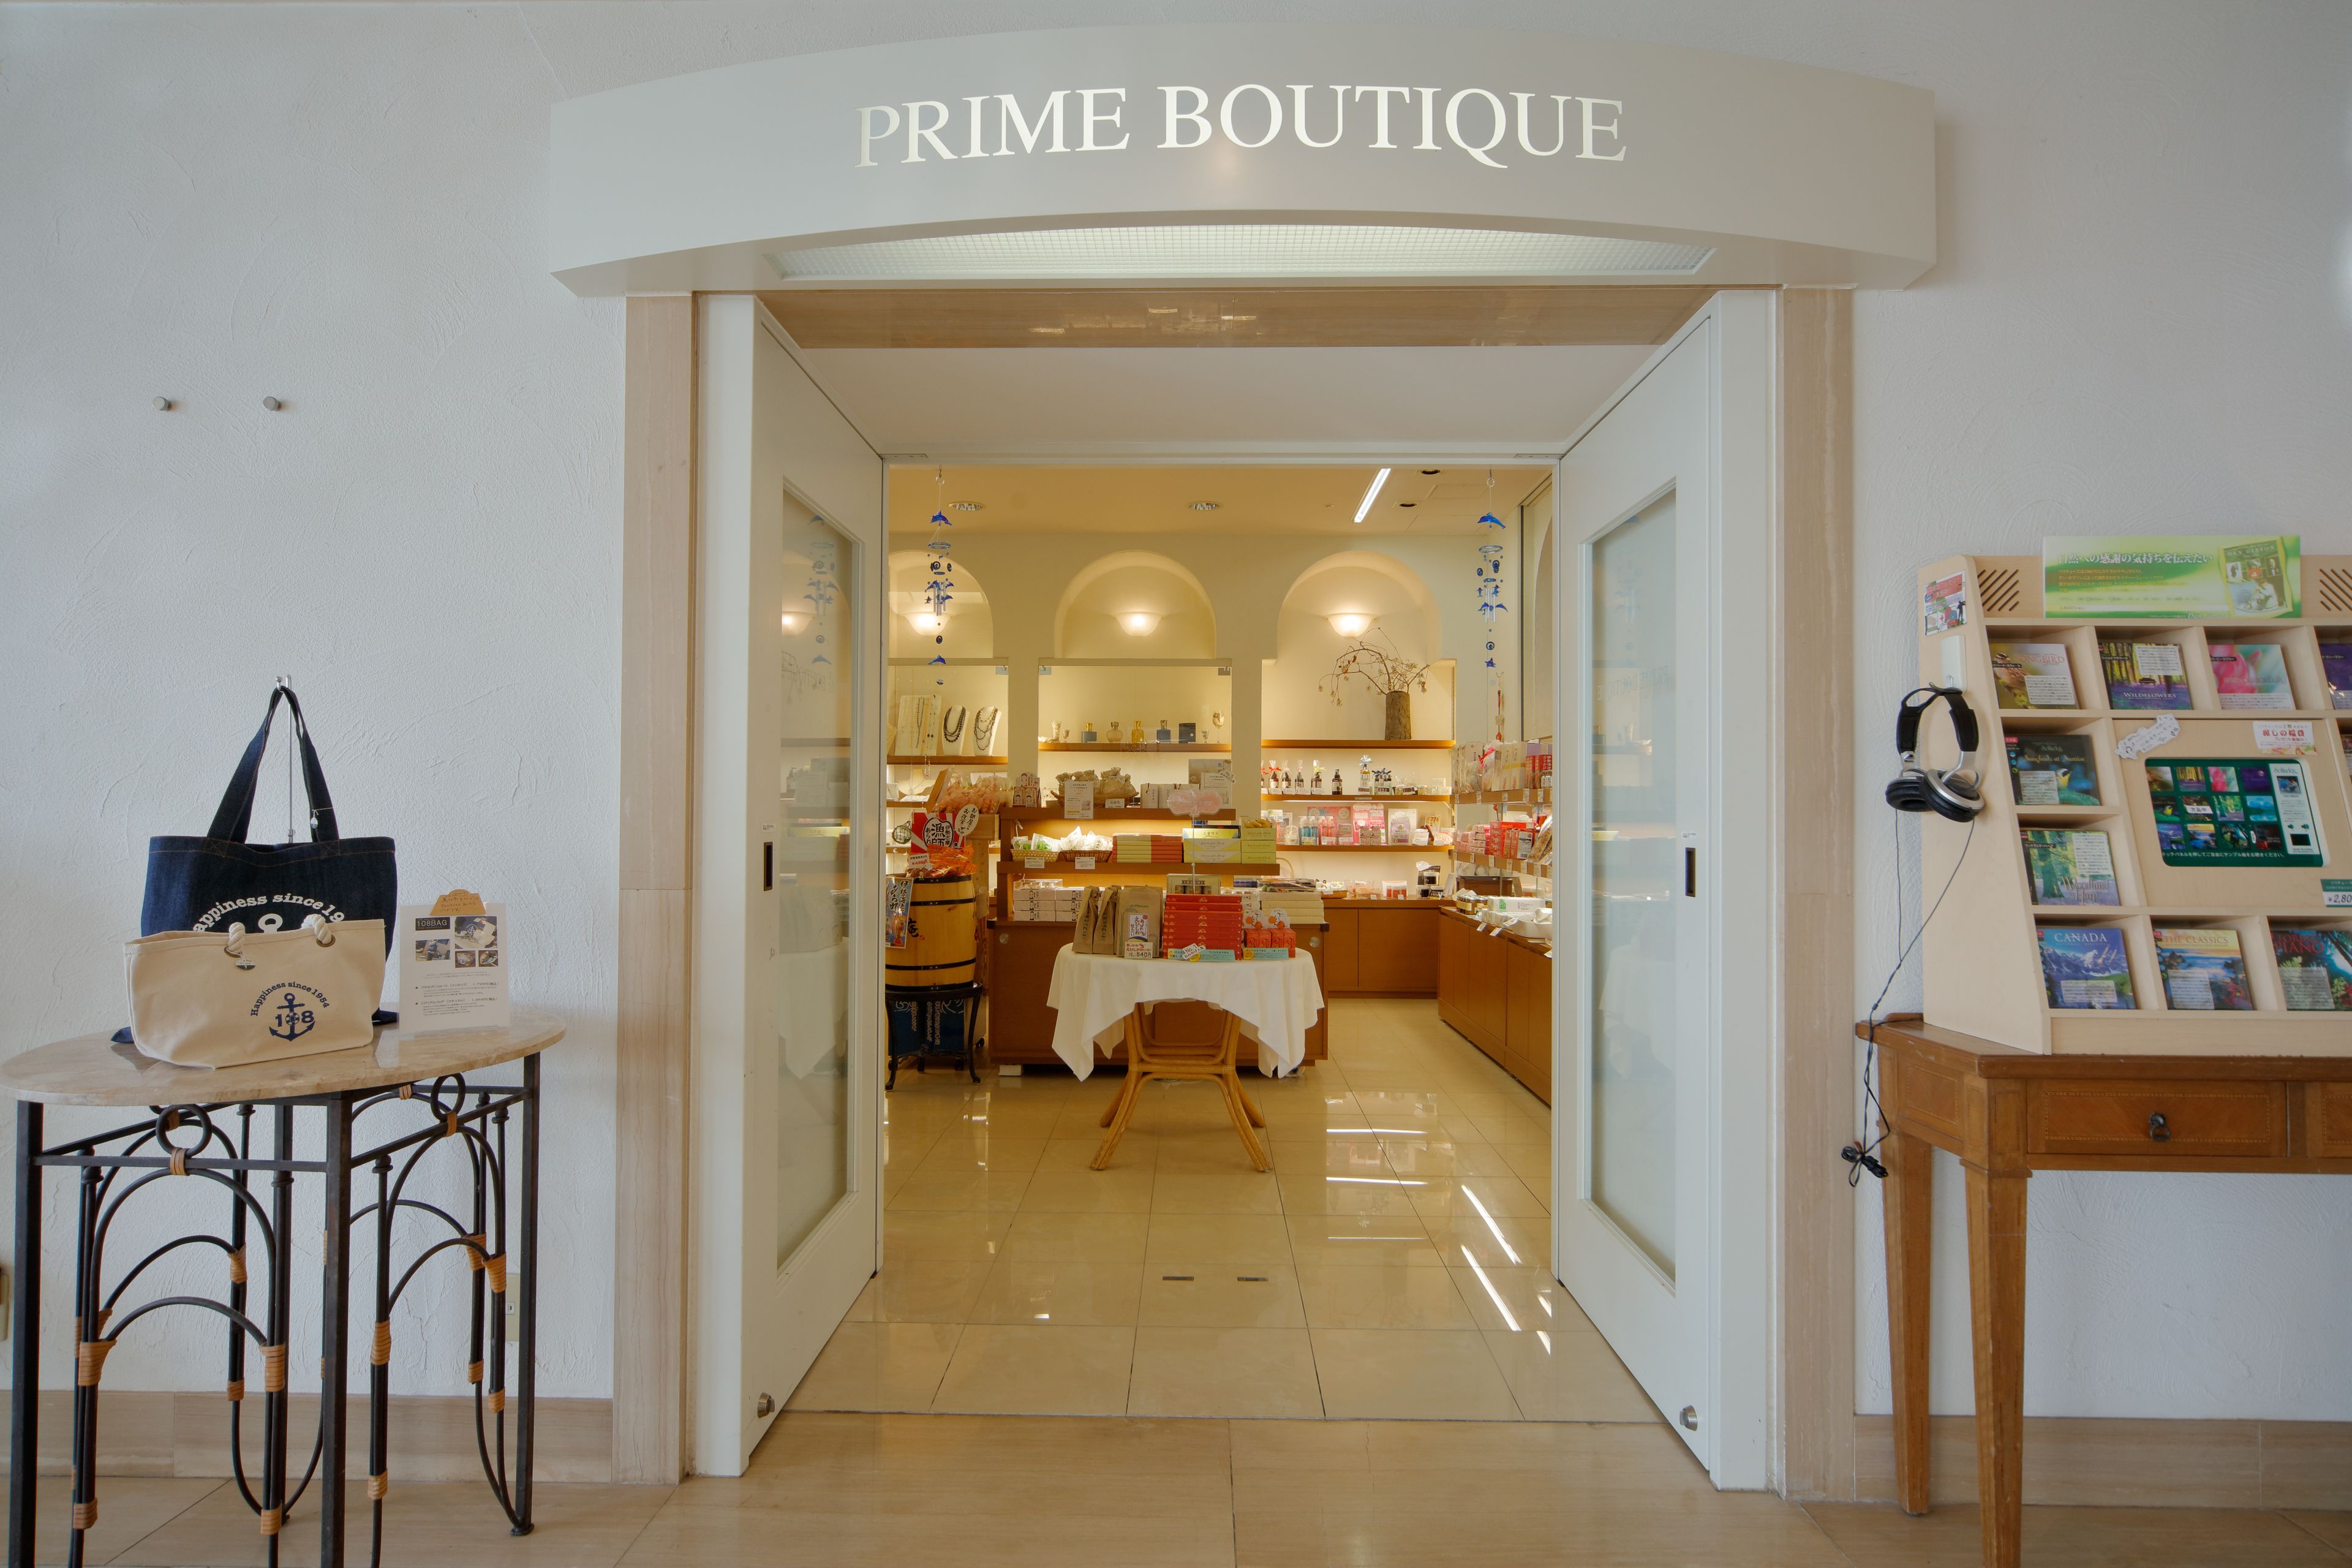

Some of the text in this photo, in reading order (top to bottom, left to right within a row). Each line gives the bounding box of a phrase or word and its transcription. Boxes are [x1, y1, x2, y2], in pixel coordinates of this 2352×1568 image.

[854, 84, 1627, 169] PRIME BOUTIQUE
[2058, 552, 2214, 564] 自然への感謝の気持ちを伝えたい
[193, 892, 345, 932] appiness since 19
[2054, 932, 2108, 943] CANADA
[2185, 935, 2230, 944] CLASSICS
[2274, 941, 2324, 954] PIANO
[250, 981, 330, 1017] Happiness since 1954
